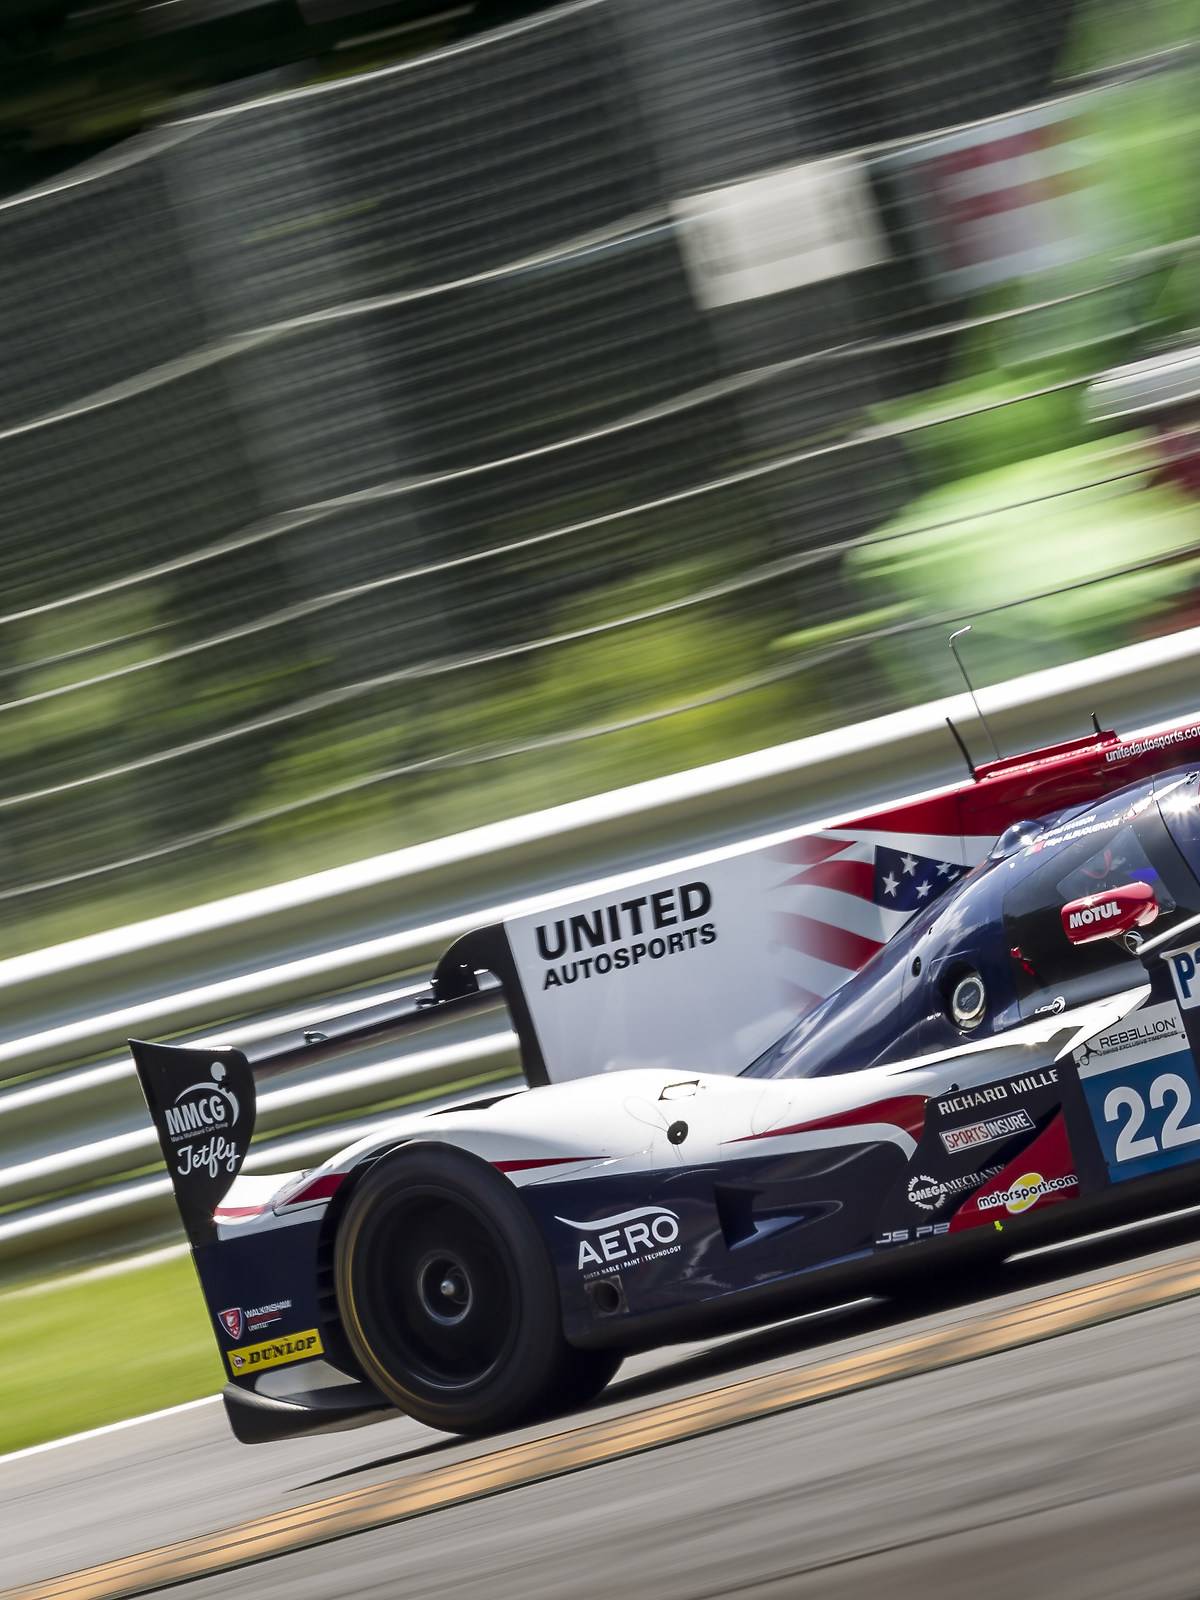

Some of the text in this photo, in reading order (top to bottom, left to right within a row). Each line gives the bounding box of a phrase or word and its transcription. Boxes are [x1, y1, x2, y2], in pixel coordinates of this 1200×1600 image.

[535, 881, 712, 961] UNITED
[1069, 901, 1122, 929] MOTUL
[543, 923, 717, 990] AUTOSPORTS
[1098, 1018, 1177, 1049] REBELLION
[937, 1069, 1059, 1116] RICHARD MILLE
[164, 1095, 226, 1136] MMCG
[177, 1136, 241, 1179] Jetfly
[978, 1174, 1079, 1210] motorsport.com
[578, 1215, 679, 1270] AERO
[875, 1229, 909, 1244] JS
[583, 1245, 682, 1280] SUSTANABLE PAINT TECHNOLOGY
[248, 1336, 317, 1364] DUNLOP
